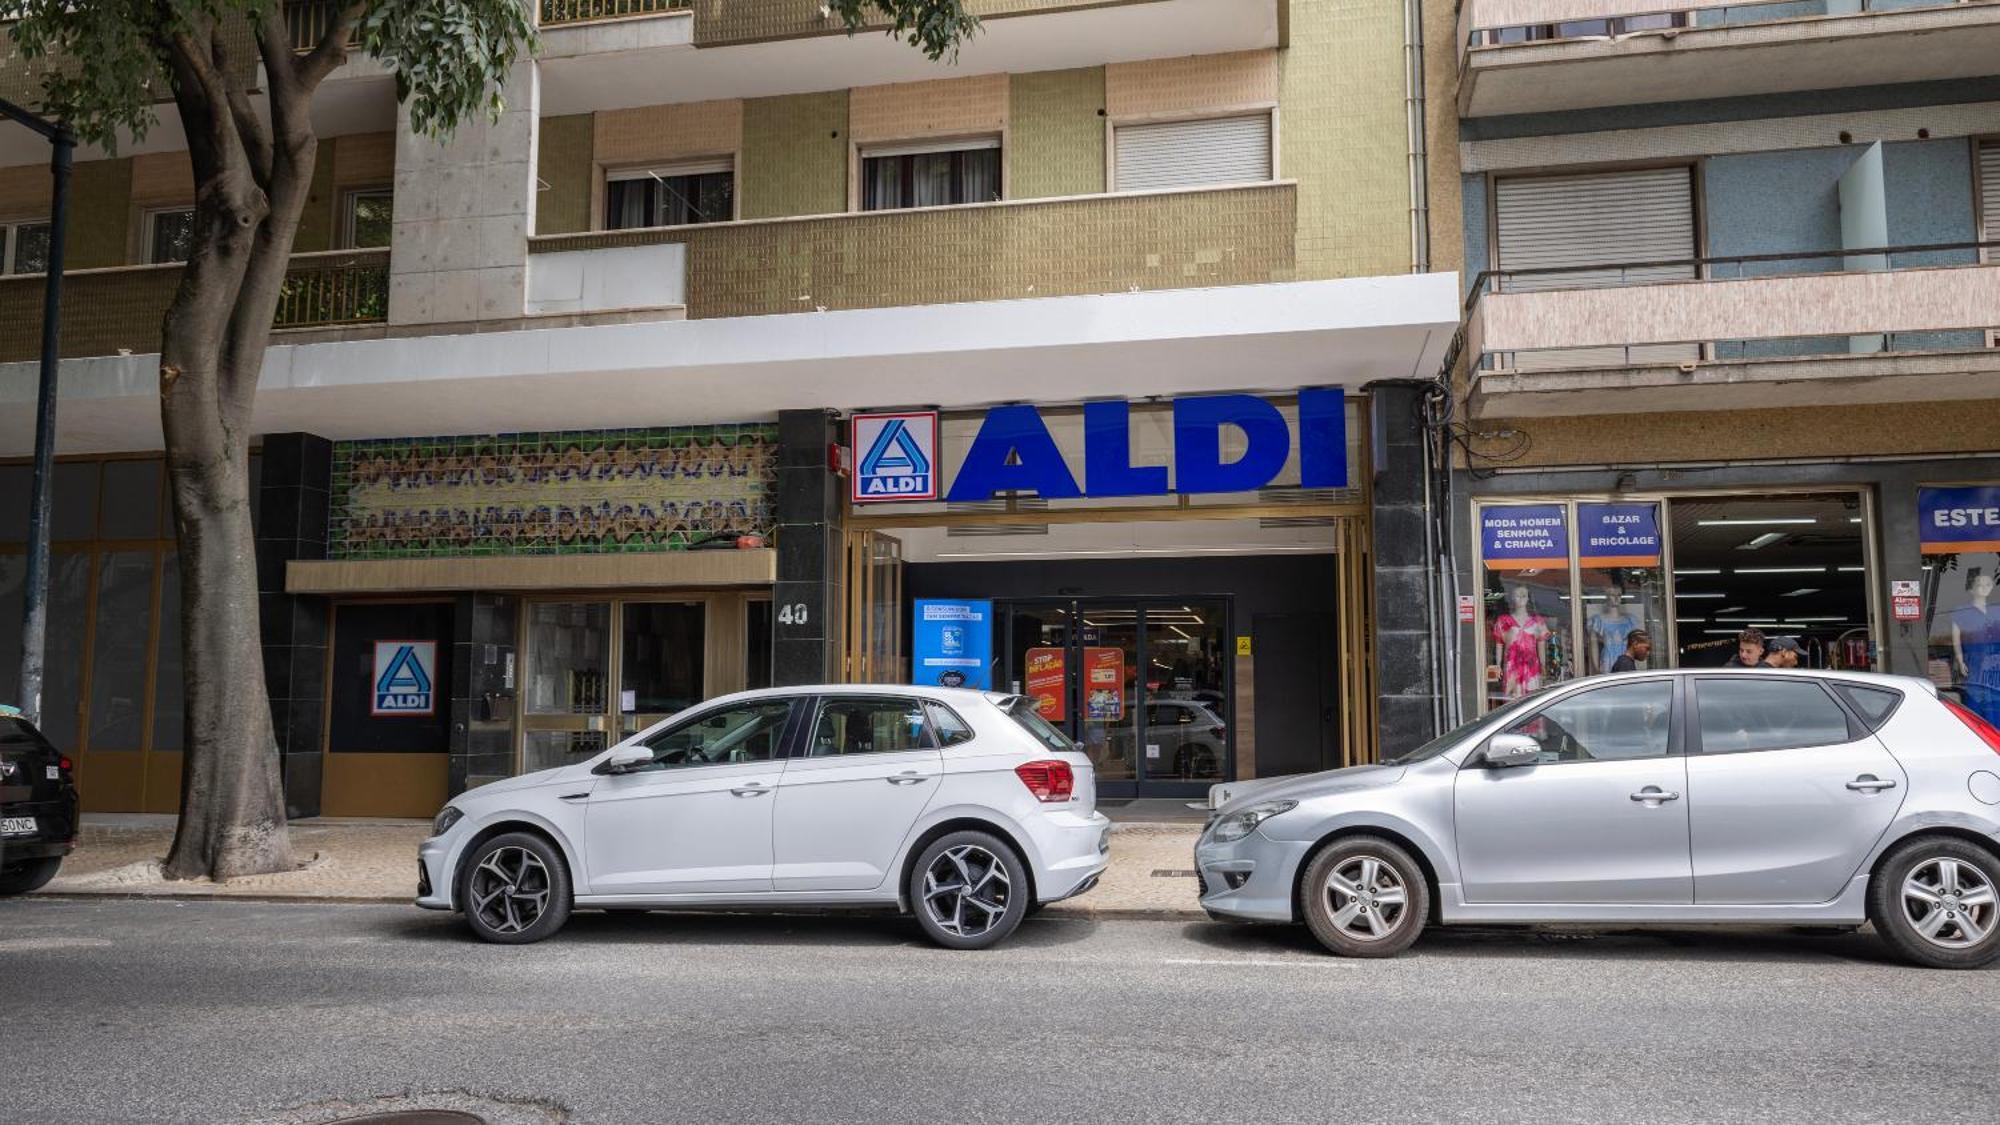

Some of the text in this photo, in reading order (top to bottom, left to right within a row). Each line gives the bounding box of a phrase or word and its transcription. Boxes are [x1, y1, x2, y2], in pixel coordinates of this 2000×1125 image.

[946, 388, 1348, 500] ALDI
[867, 477, 923, 493] ALDI
[1485, 518, 1561, 528] MODA HOMEM
[1602, 515, 1641, 524] BAZAR
[1934, 508, 2000, 527] ESTE
[1497, 529, 1550, 538] SENHORA
[1617, 526, 1626, 534] &
[1494, 539, 1554, 550] & CRIANÇA
[1591, 536, 1655, 546] BRICOLAGE
[778, 603, 808, 625] 40
[1034, 653, 1053, 665] STOP
[382, 695, 425, 708] ALDI
